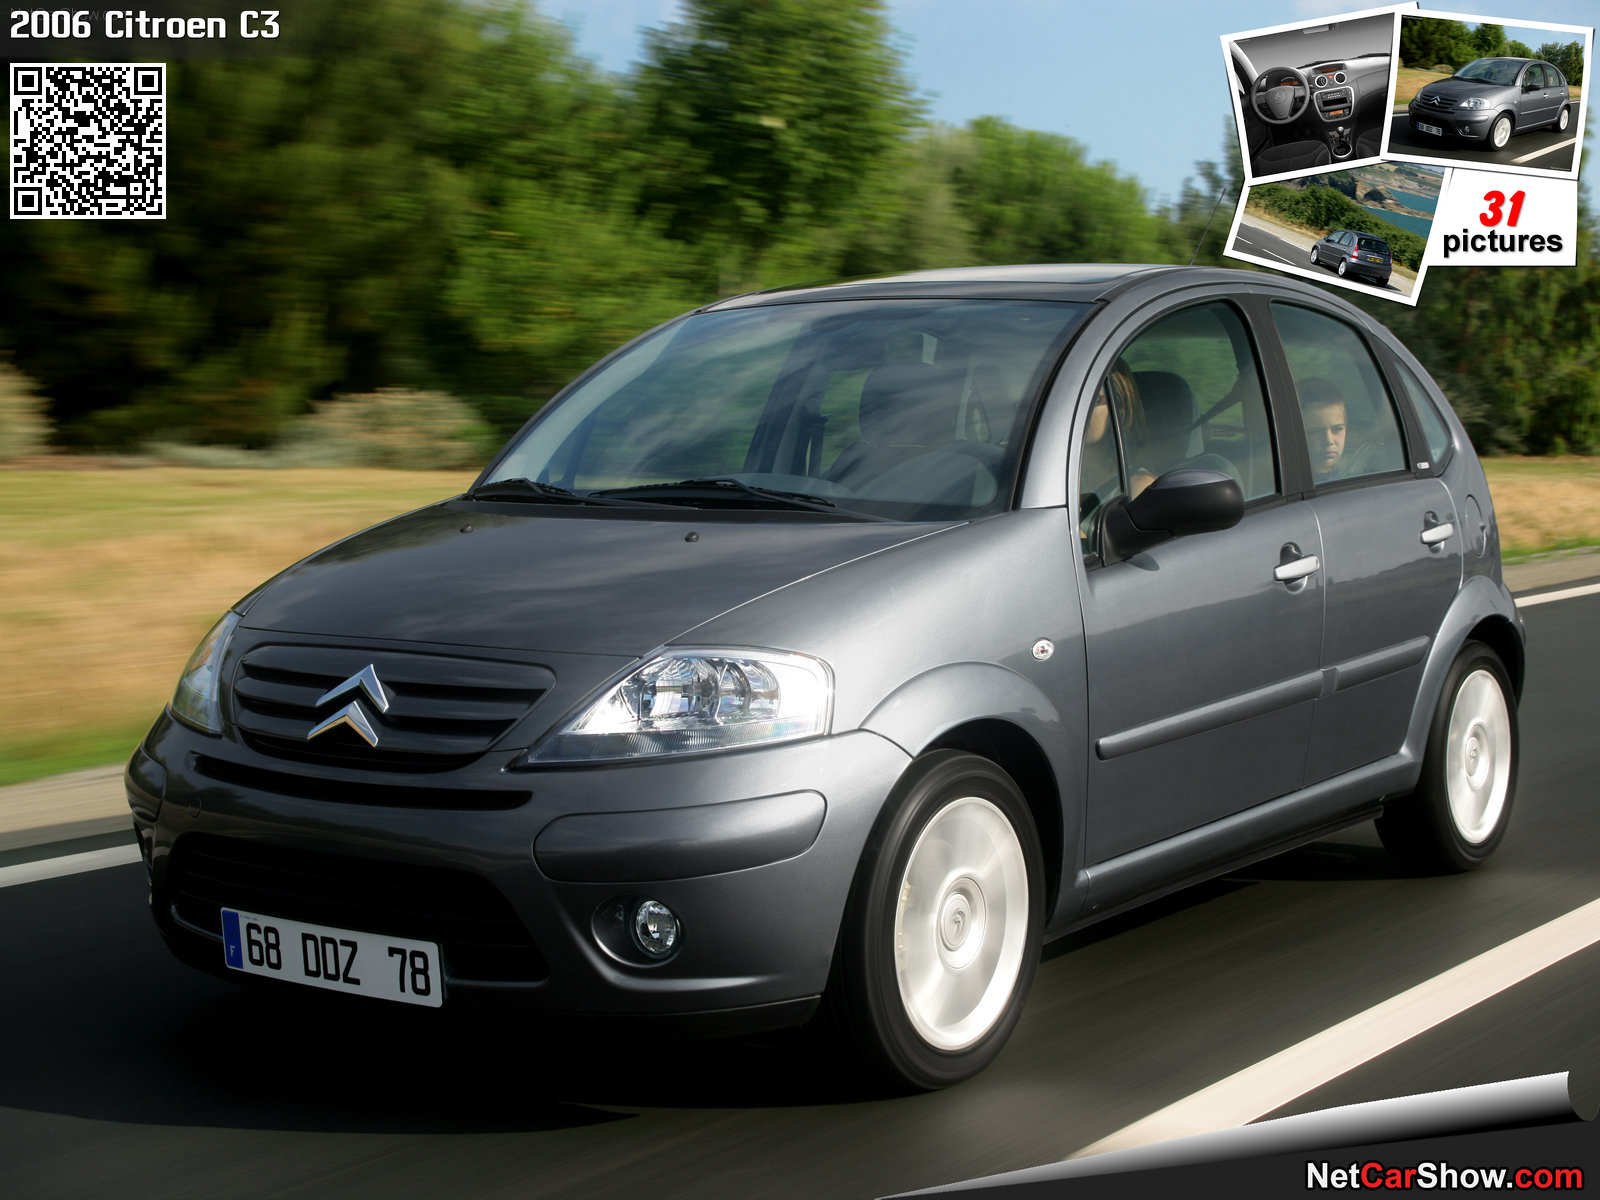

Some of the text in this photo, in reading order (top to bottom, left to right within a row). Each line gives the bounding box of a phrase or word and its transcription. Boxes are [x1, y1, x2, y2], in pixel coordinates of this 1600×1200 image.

[229, 944, 236, 957] F
[246, 922, 431, 996] 68 DDZ 78
